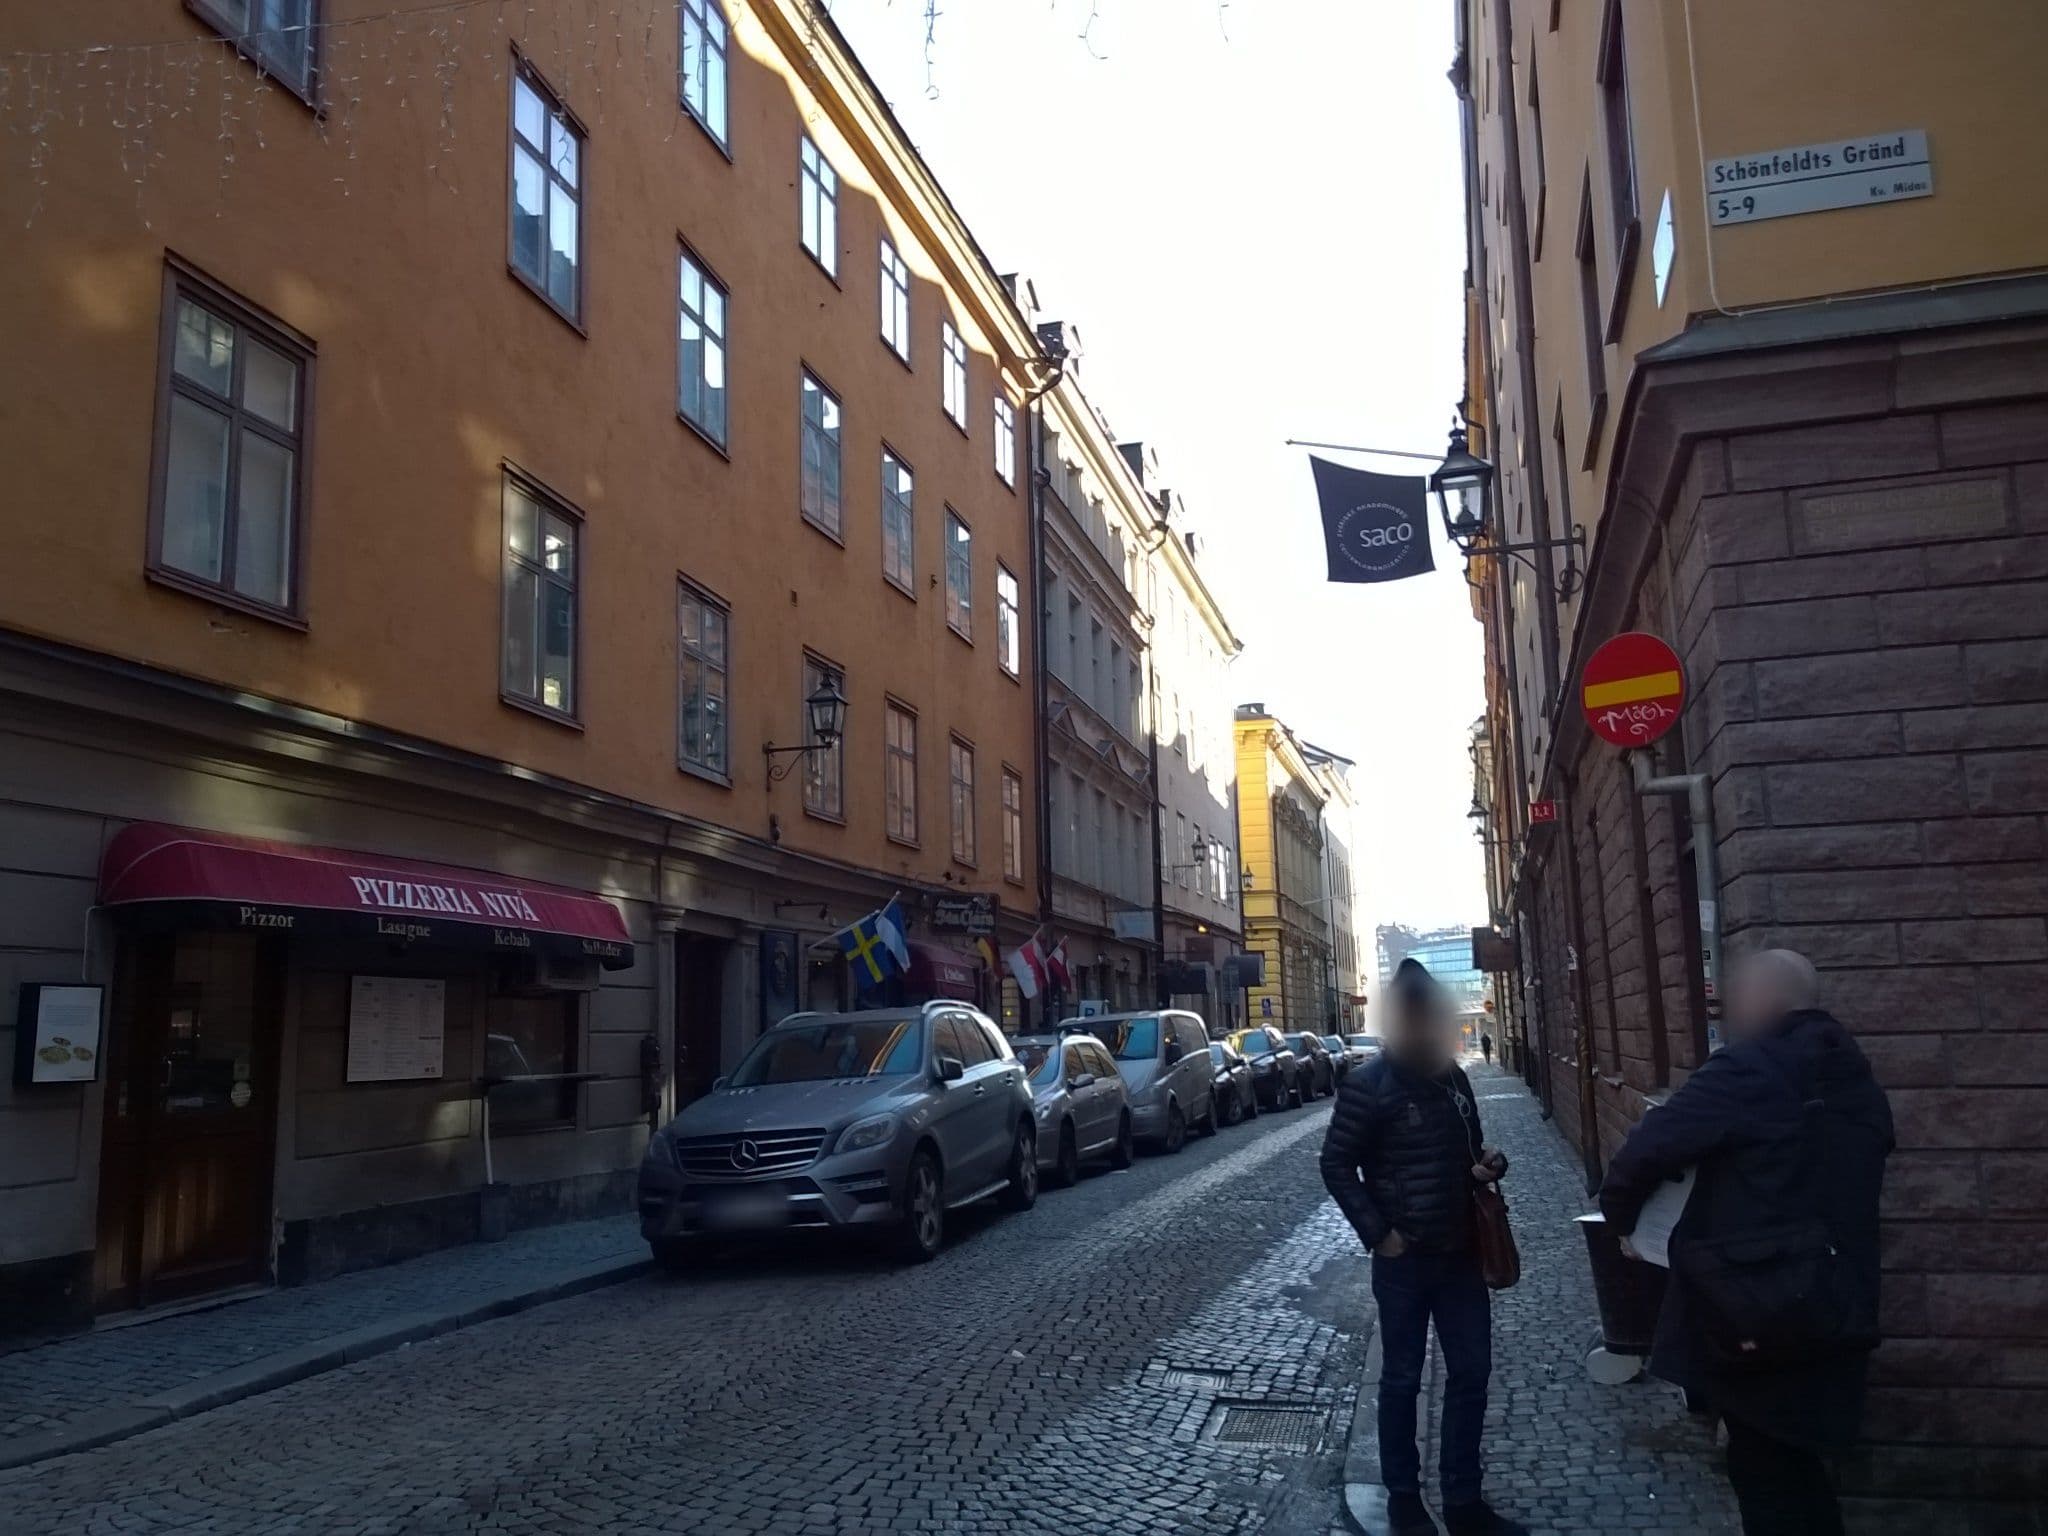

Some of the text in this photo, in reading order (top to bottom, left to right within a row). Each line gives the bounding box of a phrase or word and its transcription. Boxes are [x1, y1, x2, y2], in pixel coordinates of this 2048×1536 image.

[1715, 137, 1905, 183] Schönfeldts Gränd
[1718, 196, 1755, 218] 5-9
[1359, 523, 1412, 548] saco
[349, 876, 482, 915] PIZZERIA
[239, 906, 296, 928] Pizzor
[376, 917, 431, 942] Lasagne
[494, 929, 530, 948] Kebab
